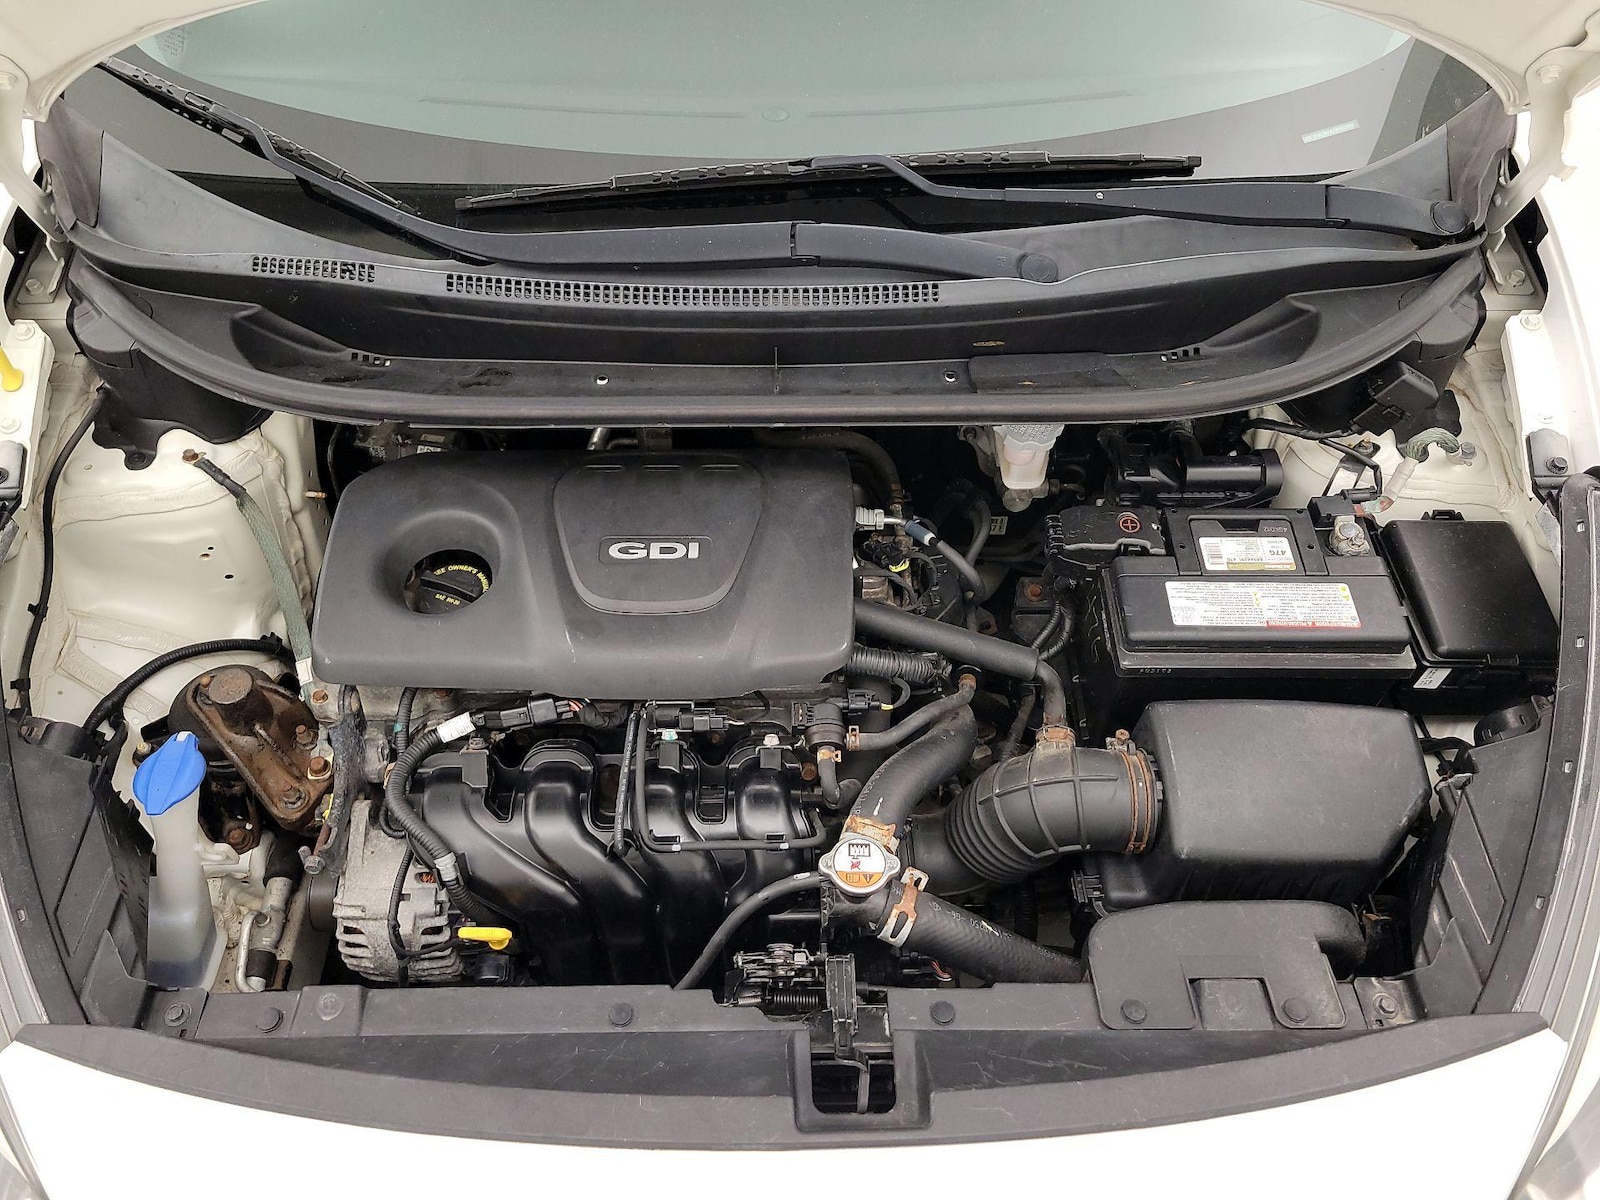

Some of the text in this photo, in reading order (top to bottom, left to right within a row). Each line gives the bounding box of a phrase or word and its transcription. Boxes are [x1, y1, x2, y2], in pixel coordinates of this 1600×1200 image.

[608, 541, 700, 560] GDI
[433, 567, 447, 576] SEE
[434, 593, 447, 601] SAE
